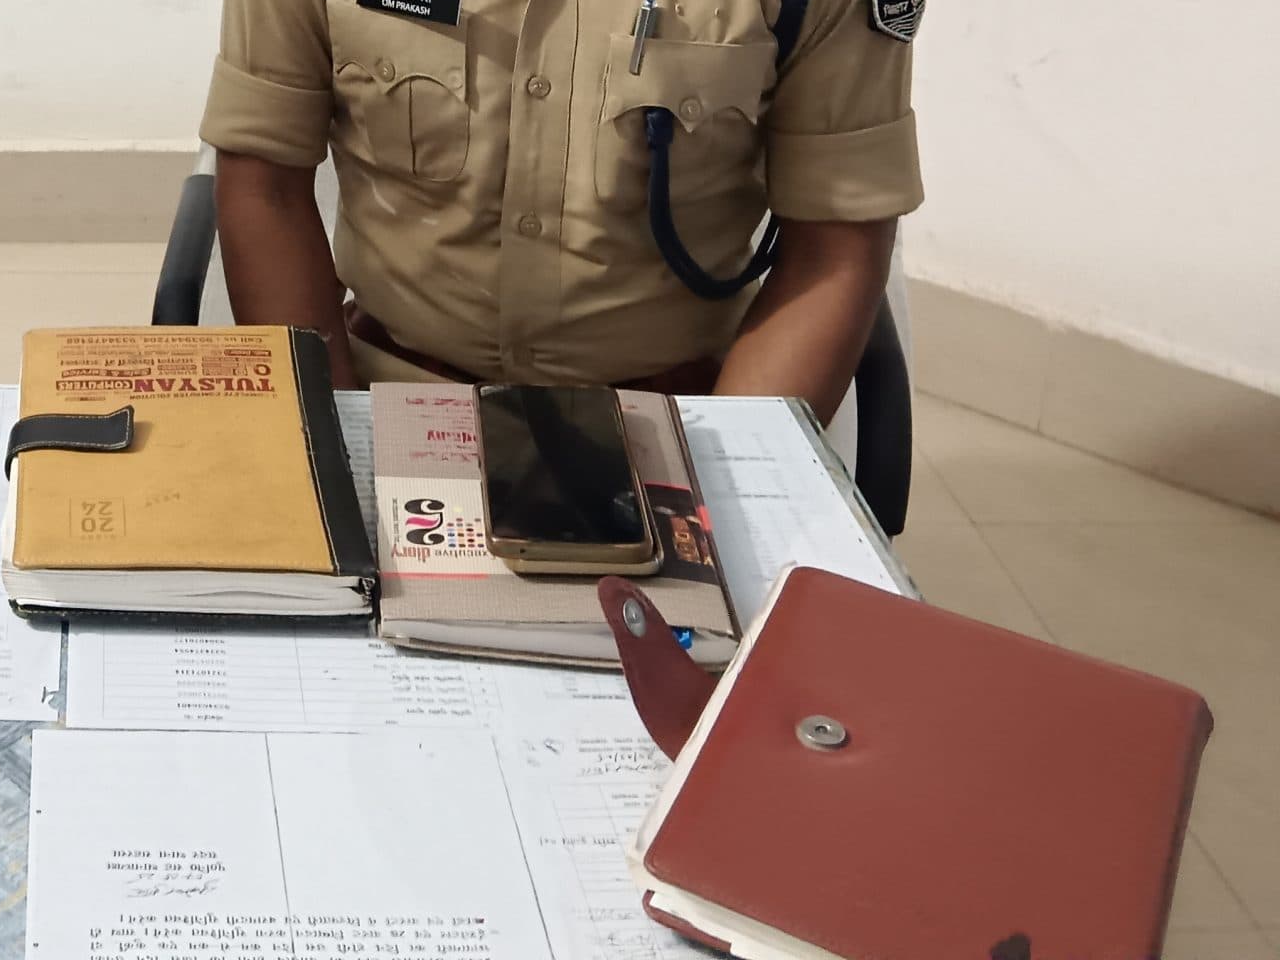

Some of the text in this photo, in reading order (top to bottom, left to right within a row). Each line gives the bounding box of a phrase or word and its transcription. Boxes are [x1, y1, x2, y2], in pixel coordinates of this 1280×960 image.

[396, 1, 431, 16] PRAKASH
[57, 380, 132, 391] COMPUTERS
[133, 377, 275, 393] TULSYAN
[81, 501, 113, 516] 24
[80, 516, 114, 533] 20
[391, 543, 431, 563] diary
